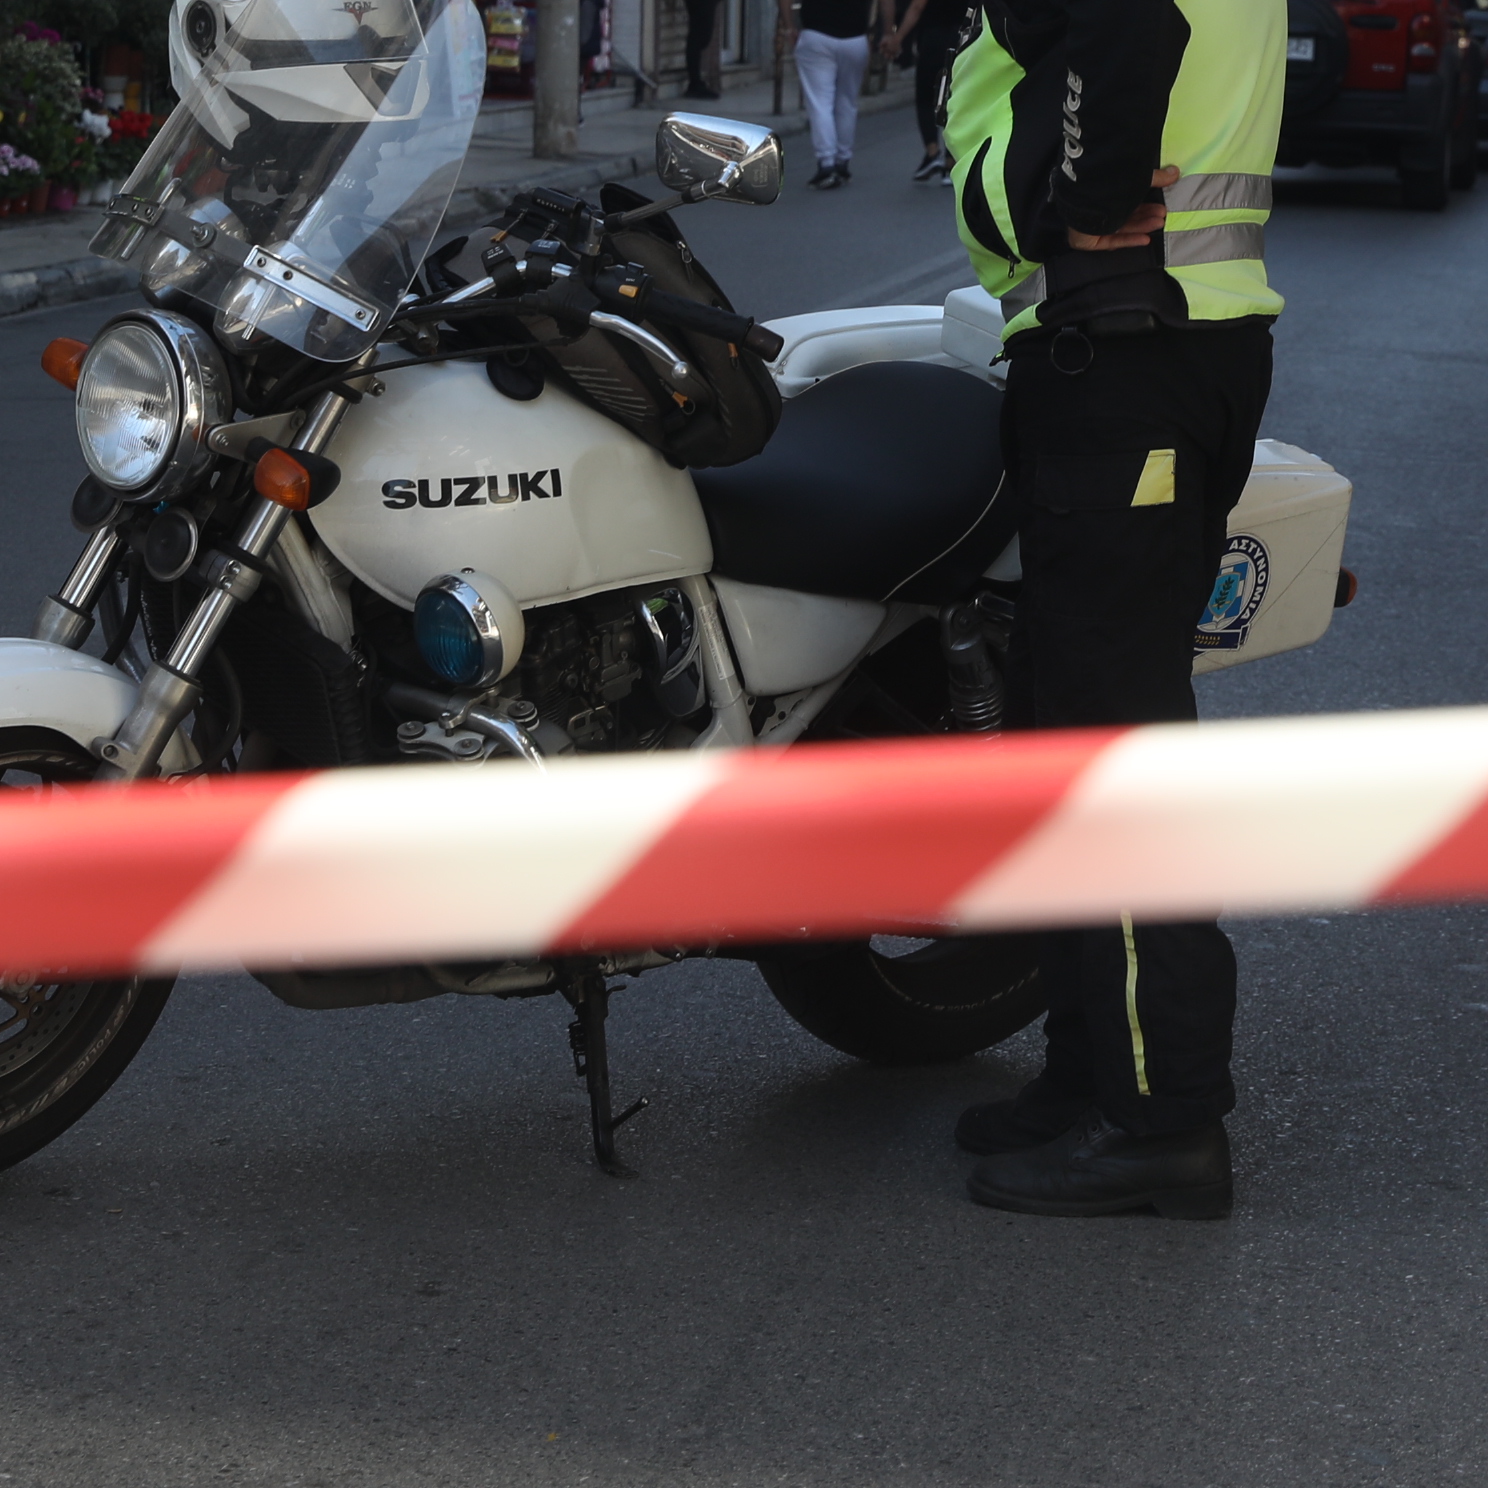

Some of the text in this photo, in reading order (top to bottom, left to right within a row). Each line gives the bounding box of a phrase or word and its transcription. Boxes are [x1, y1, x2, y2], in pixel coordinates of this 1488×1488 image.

[1061, 69, 1085, 183] POLICE
[381, 467, 563, 511] SUZUKI
[1229, 539, 1267, 620] ΑΣΤΥΝΟΜΙΑ
